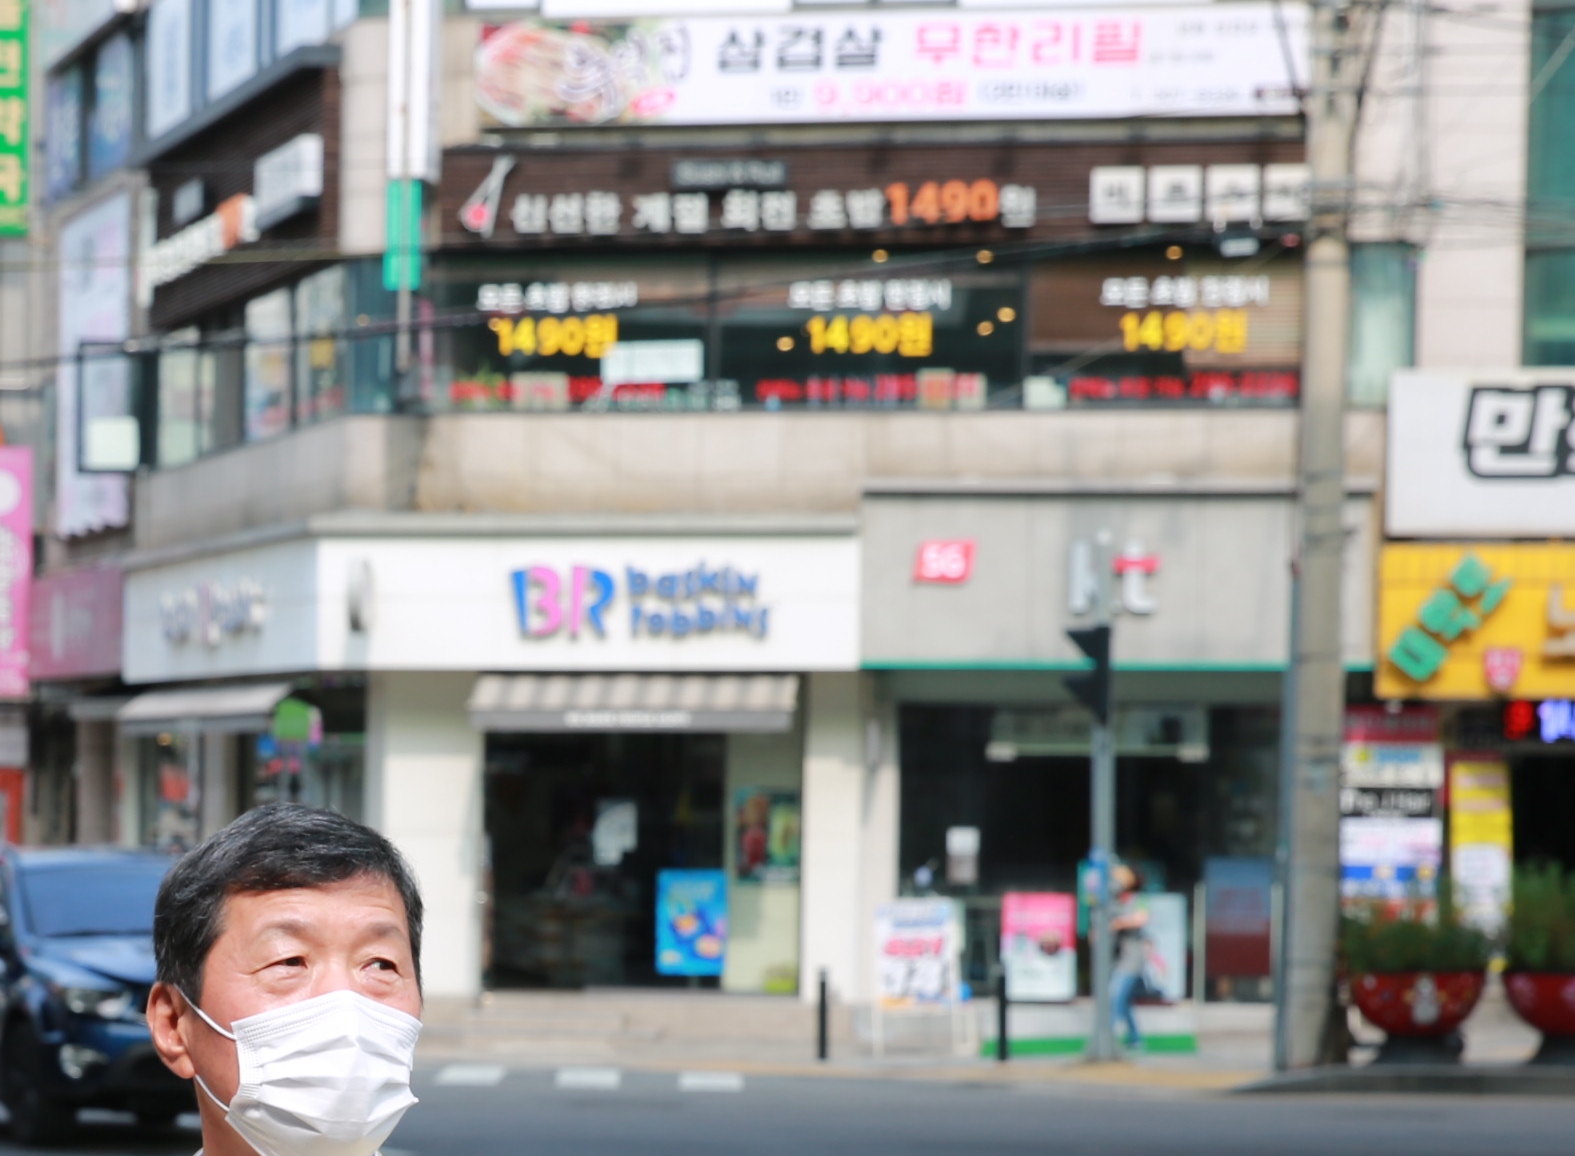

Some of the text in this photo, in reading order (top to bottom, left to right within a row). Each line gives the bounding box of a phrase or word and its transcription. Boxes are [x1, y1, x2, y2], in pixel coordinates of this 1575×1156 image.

[717, 20, 1143, 72] 삼겹살 무한리필
[512, 190, 621, 235] 신선한
[806, 312, 933, 357] 1490원
[1119, 309, 1249, 353] 1490원
[1466, 385, 1575, 479] 만
[510, 563, 616, 638] BR
